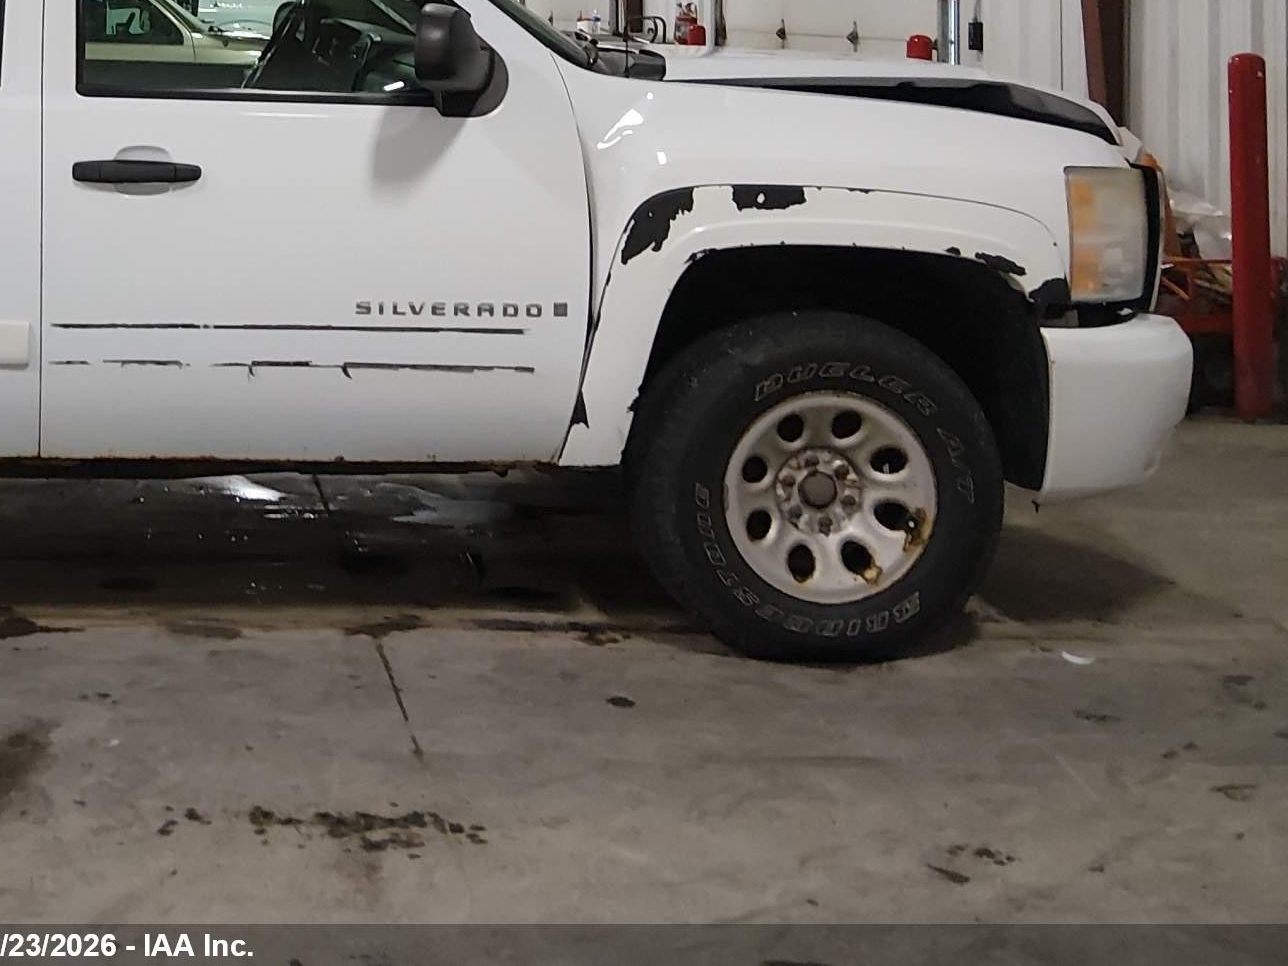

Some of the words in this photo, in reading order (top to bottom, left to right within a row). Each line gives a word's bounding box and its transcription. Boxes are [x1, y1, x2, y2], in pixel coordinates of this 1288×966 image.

[355, 301, 543, 318] SILVERADO
[754, 361, 941, 417] DUELER
[936, 426, 976, 505] A/T
[693, 482, 922, 637] BRIDGESTONE
